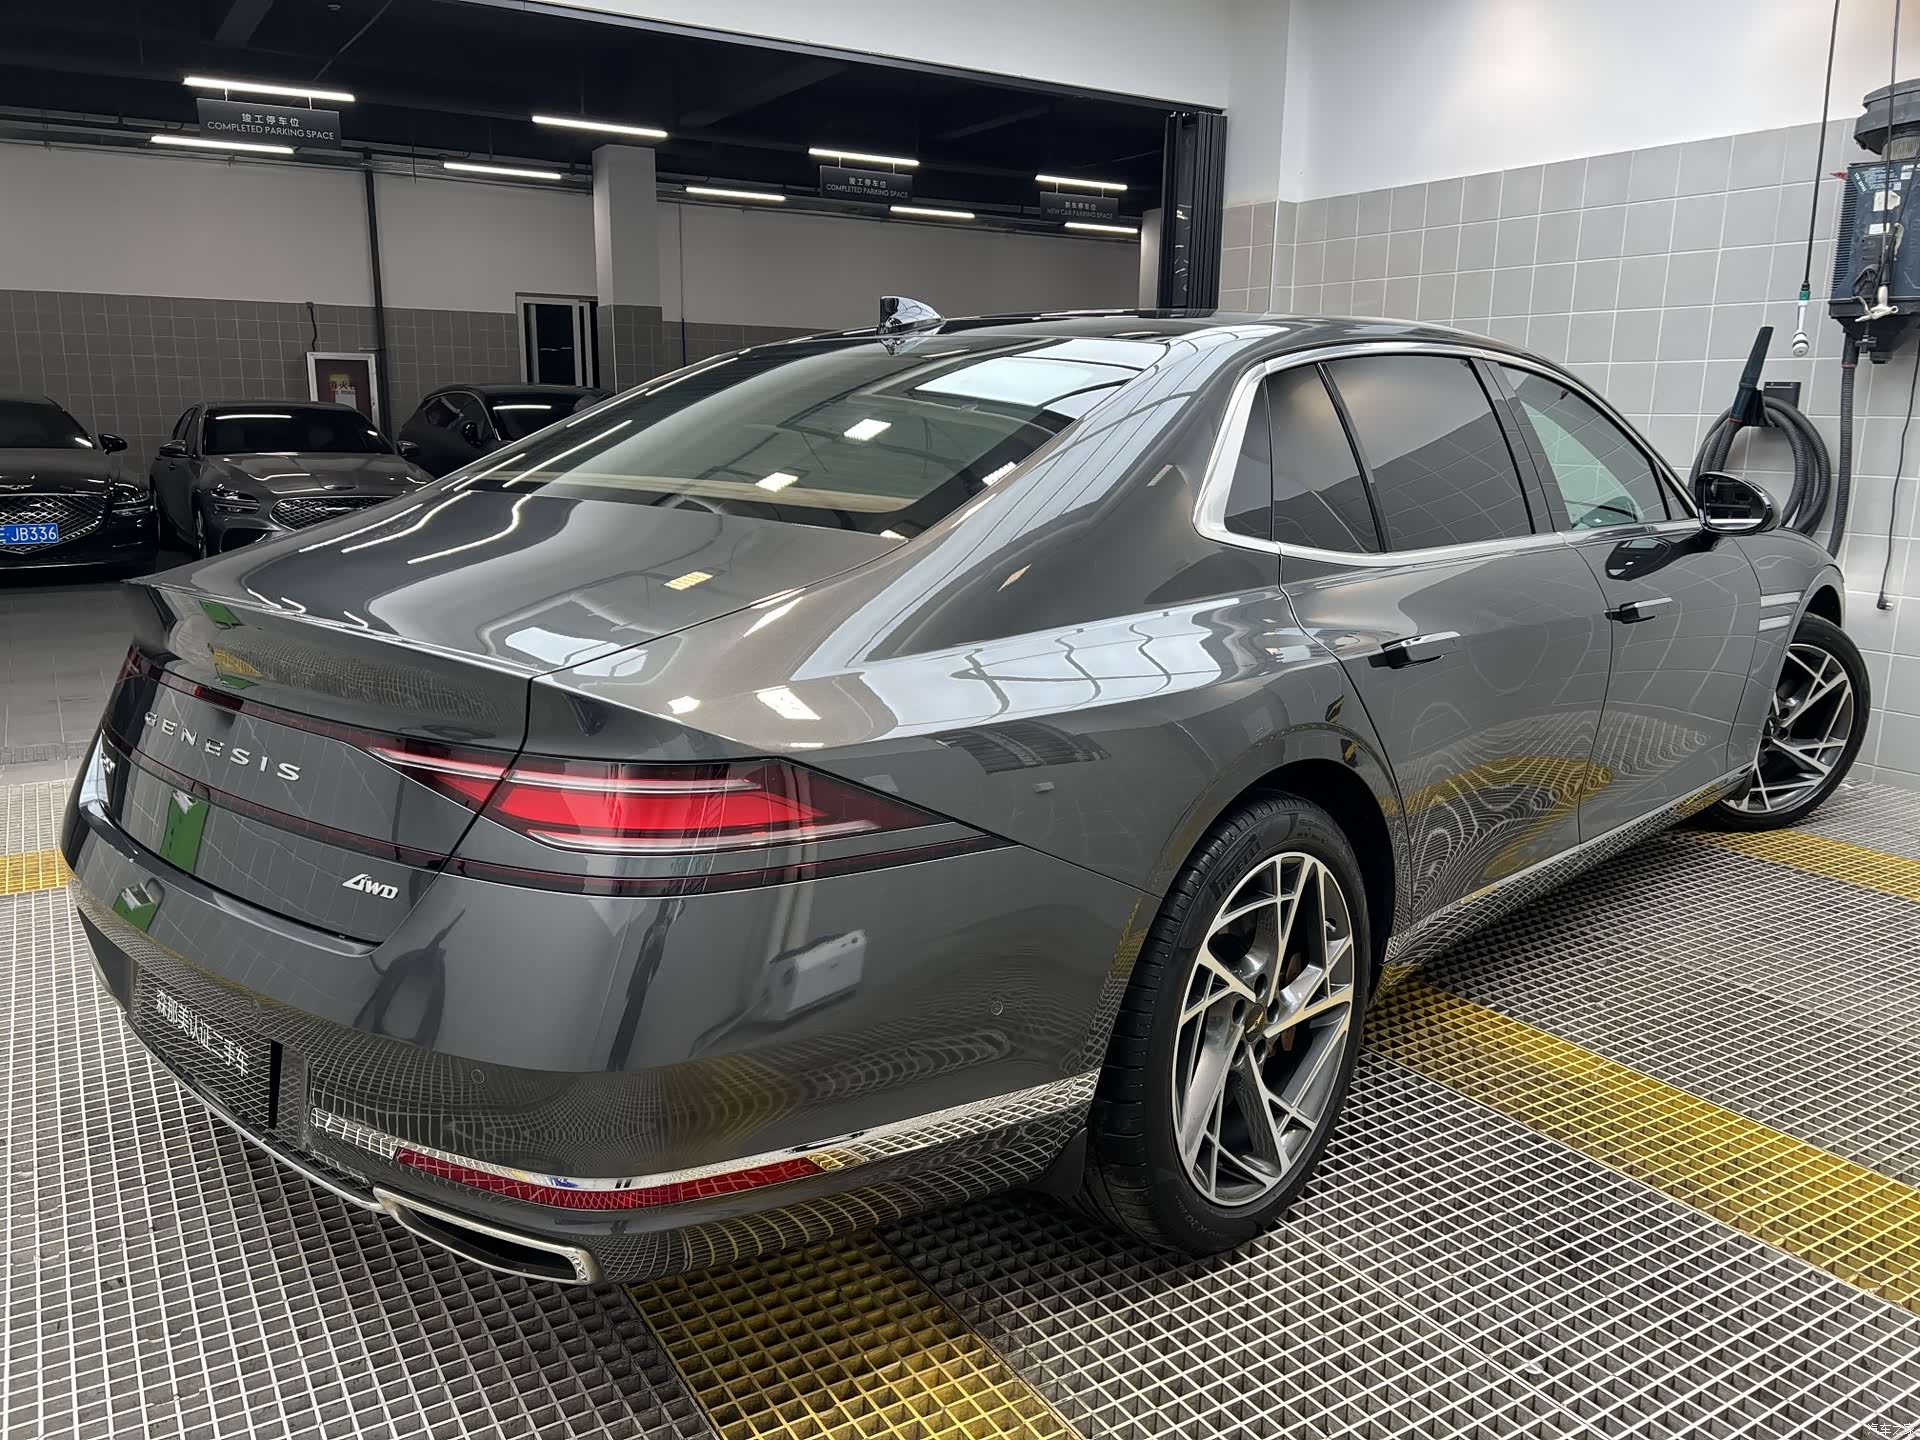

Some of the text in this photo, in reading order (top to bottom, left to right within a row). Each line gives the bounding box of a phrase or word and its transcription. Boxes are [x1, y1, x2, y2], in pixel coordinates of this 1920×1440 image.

[241, 112, 300, 127] 竣工停车位
[207, 121, 334, 140] COMPLETED PARKING SPACE
[826, 183, 909, 199] COMPLETED PARKING SPACE
[848, 177, 887, 189] 竣工停车位
[144, 711, 301, 781] GENESIS
